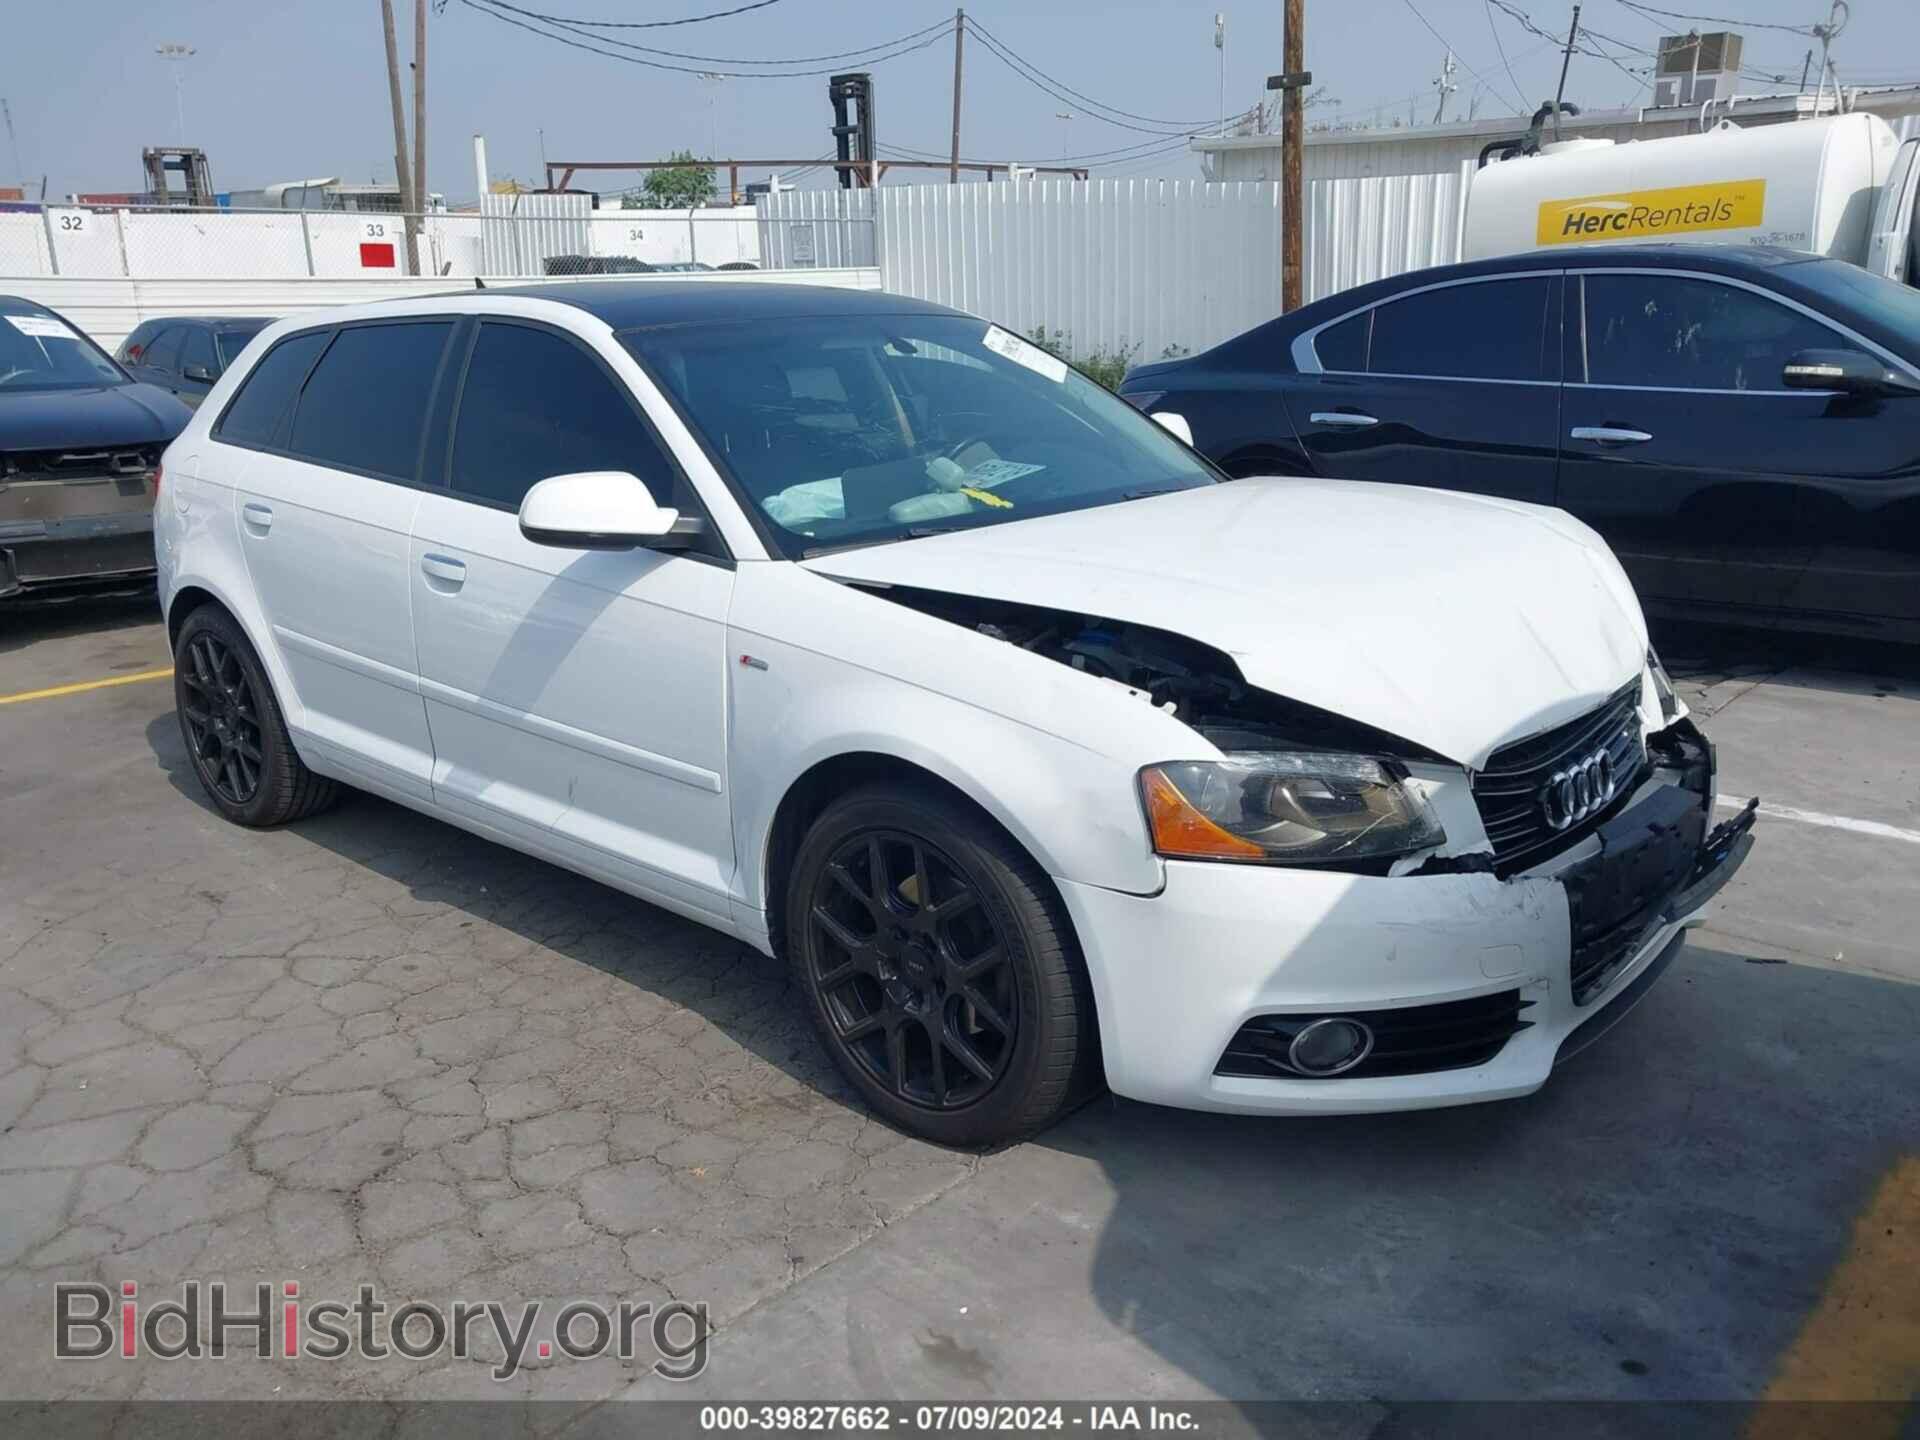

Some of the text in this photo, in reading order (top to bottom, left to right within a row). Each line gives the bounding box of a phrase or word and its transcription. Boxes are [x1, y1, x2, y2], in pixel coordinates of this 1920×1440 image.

[60, 215, 83, 230] 32
[366, 223, 385, 237] 33
[629, 229, 643, 241] 34
